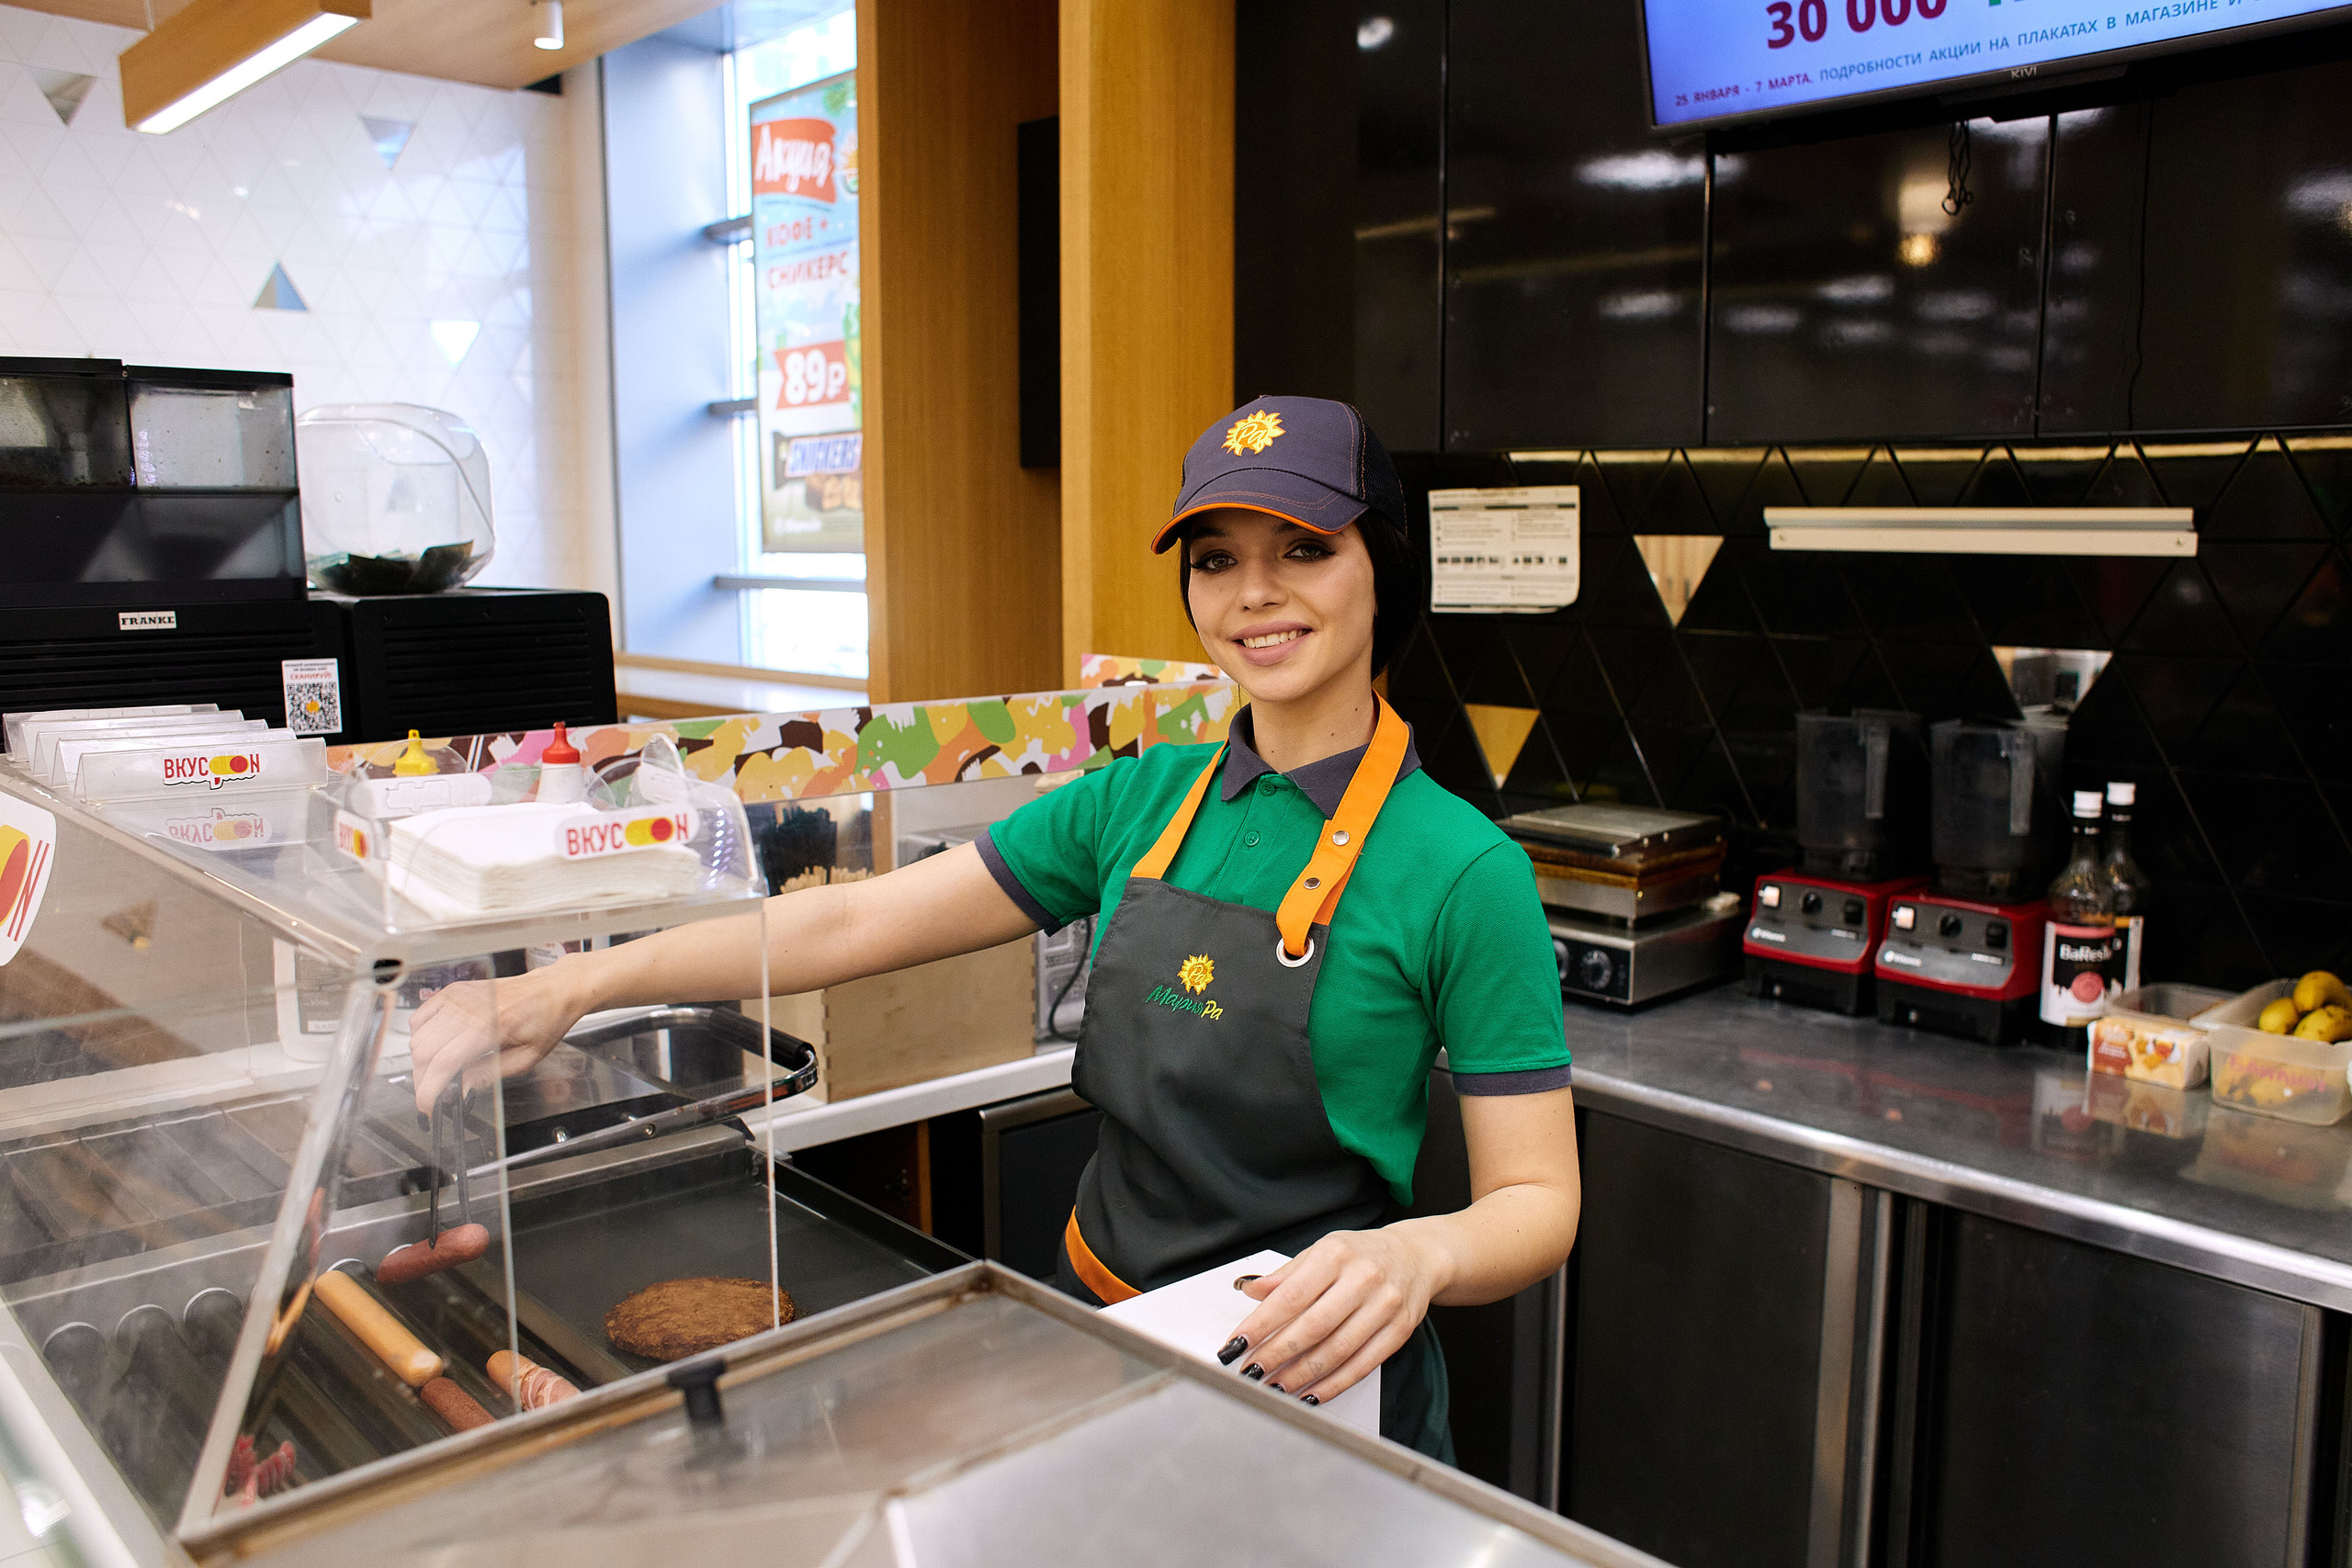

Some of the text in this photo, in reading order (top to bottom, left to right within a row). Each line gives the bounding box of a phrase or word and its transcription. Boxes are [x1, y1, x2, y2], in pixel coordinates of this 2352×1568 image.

[1766, 0, 1827, 49] 30
[1675, 95, 1689, 107] 25
[1693, 85, 1740, 103] ЯНВАРЯ
[1755, 81, 1762, 92] 7
[1819, 52, 1922, 82] ПОДРОБНОСТИ
[1929, 42, 1981, 62] АКЦИИ
[1989, 37, 2010, 51] НА
[2018, 18, 2098, 46] ПЛАКАТАХ
[2107, 17, 2117, 29] В
[2010, 66, 2037, 80] KIVI
[766, 215, 813, 248] КОФЕ
[768, 251, 848, 289] СНИКЕРС
[121, 616, 175, 626] FRANKE
